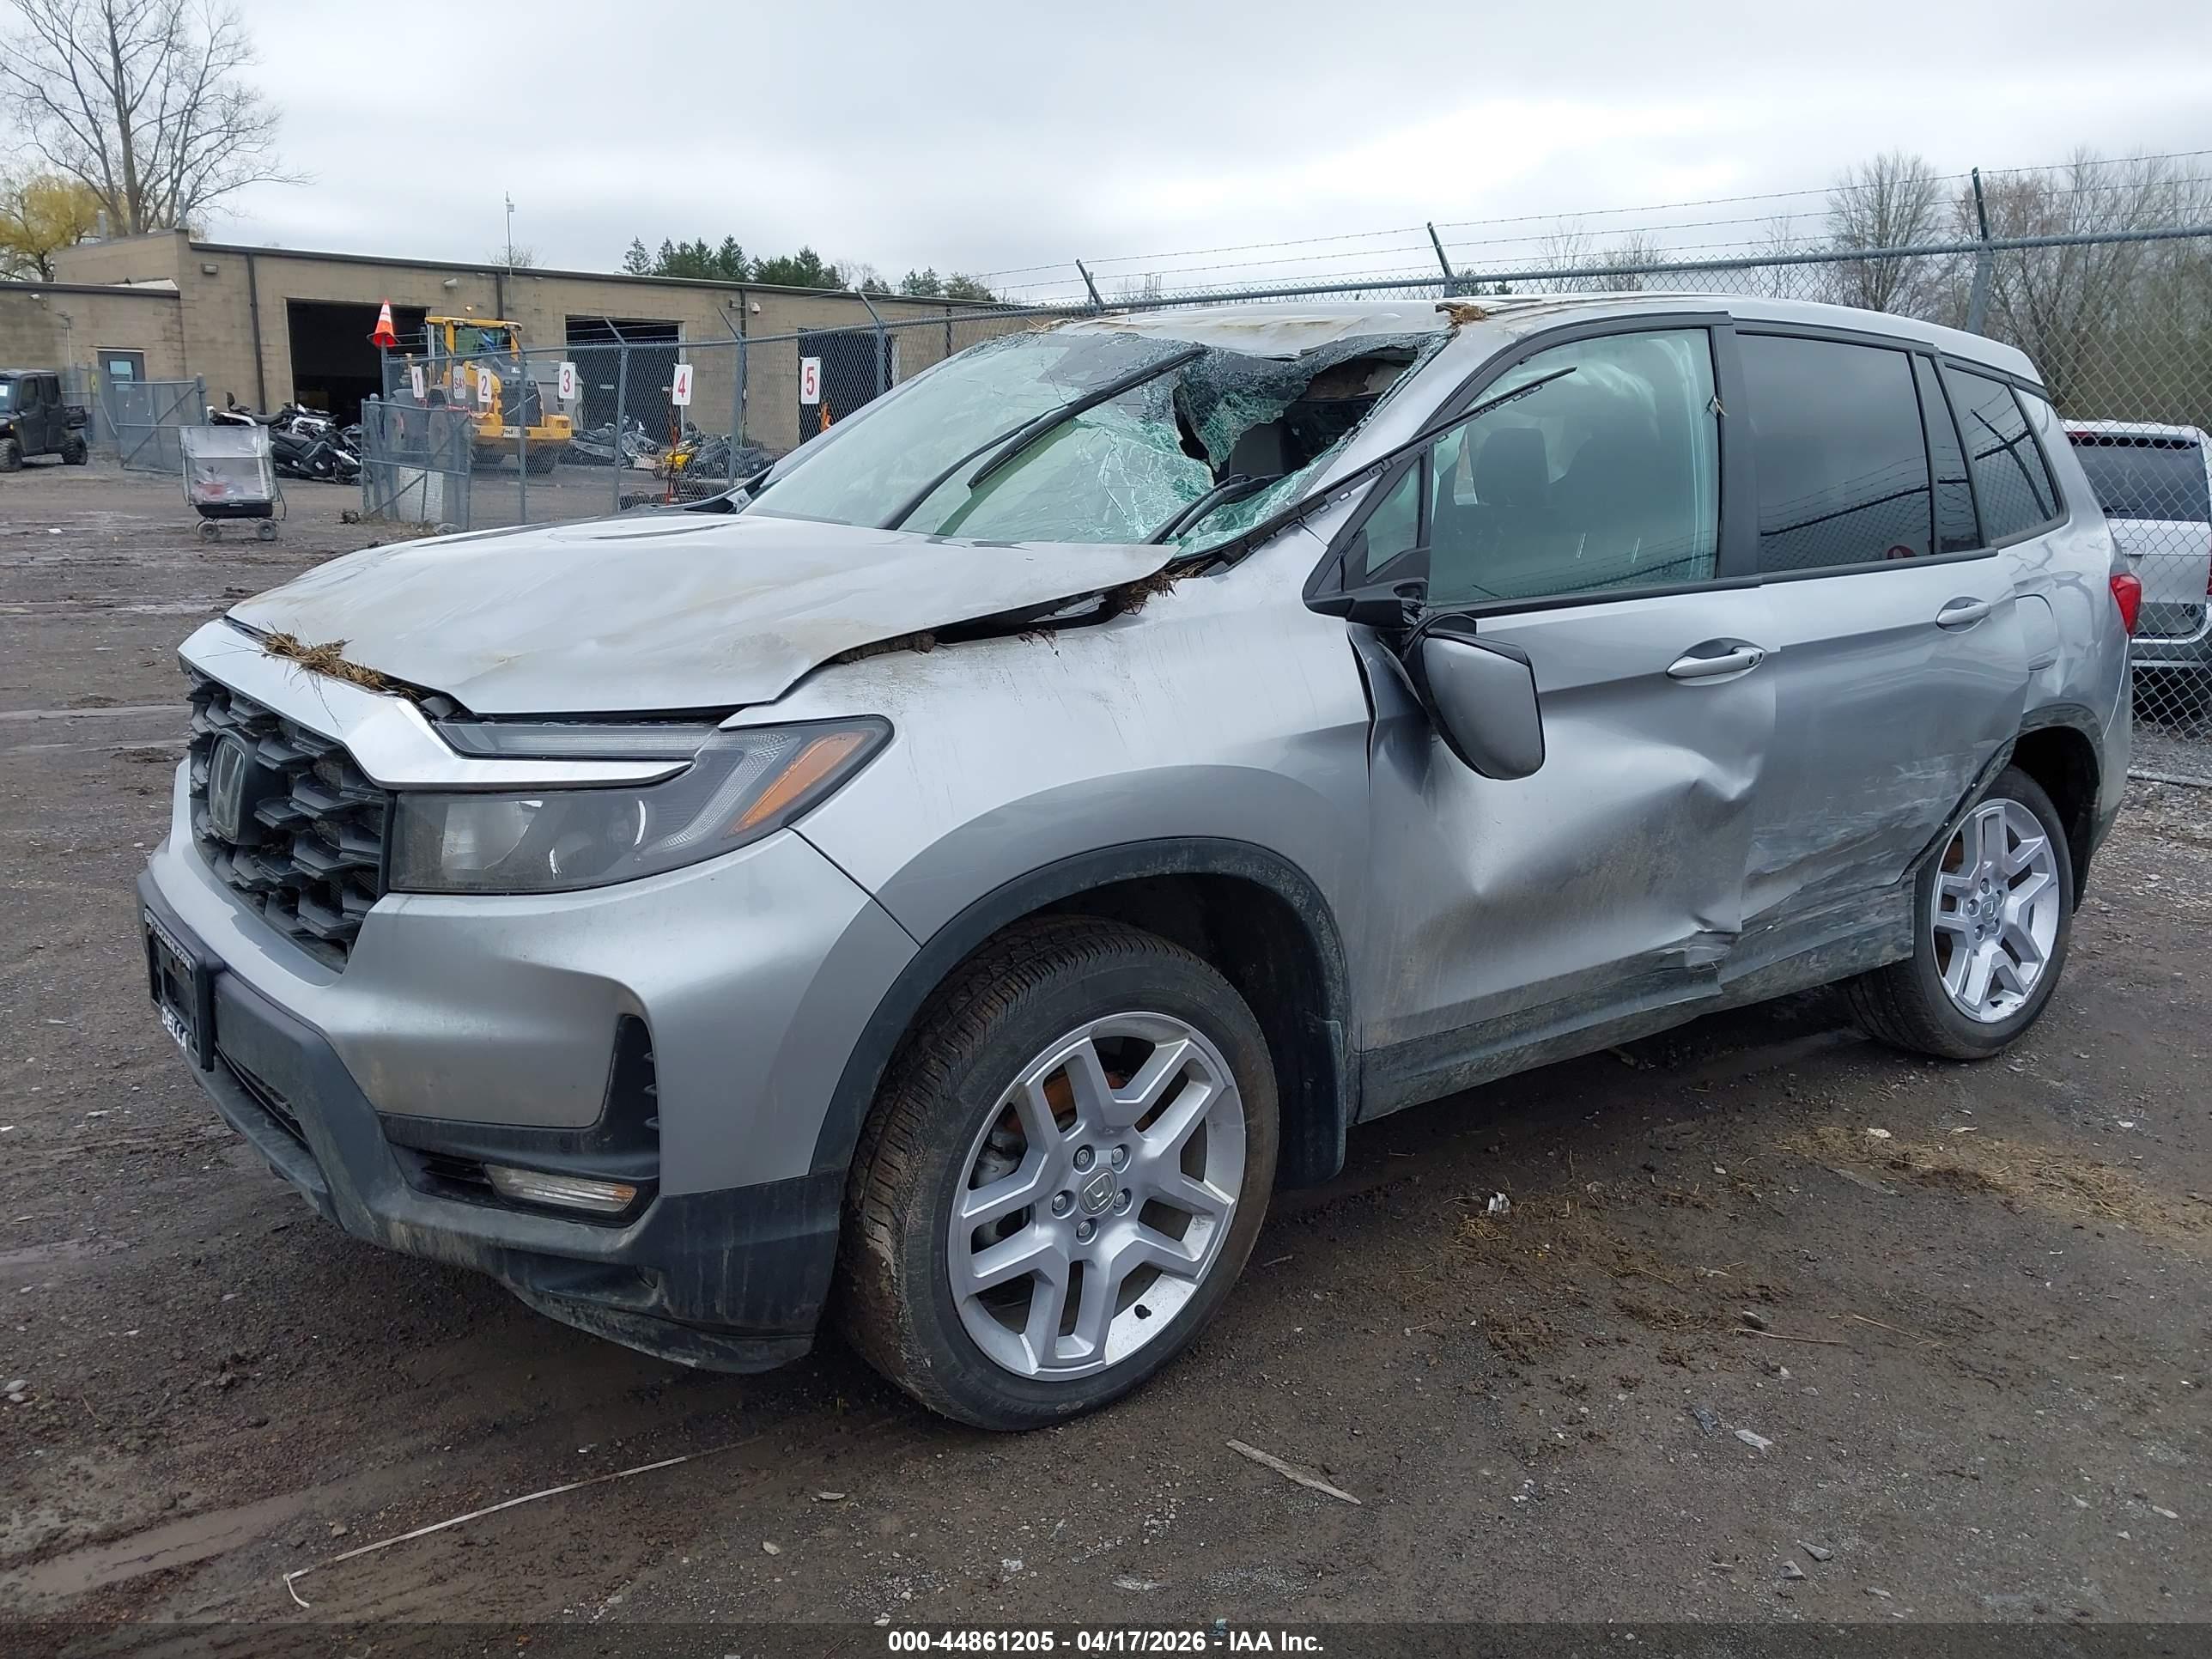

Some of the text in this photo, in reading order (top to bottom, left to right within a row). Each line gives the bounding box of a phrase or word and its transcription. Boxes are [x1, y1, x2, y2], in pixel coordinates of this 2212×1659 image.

[415, 372, 421, 392] 1
[481, 375, 488, 397] 2
[562, 369, 571, 393] 3
[678, 373, 686, 398] 4
[805, 366, 815, 396] 5
[161, 1006, 188, 1052] DELLA
